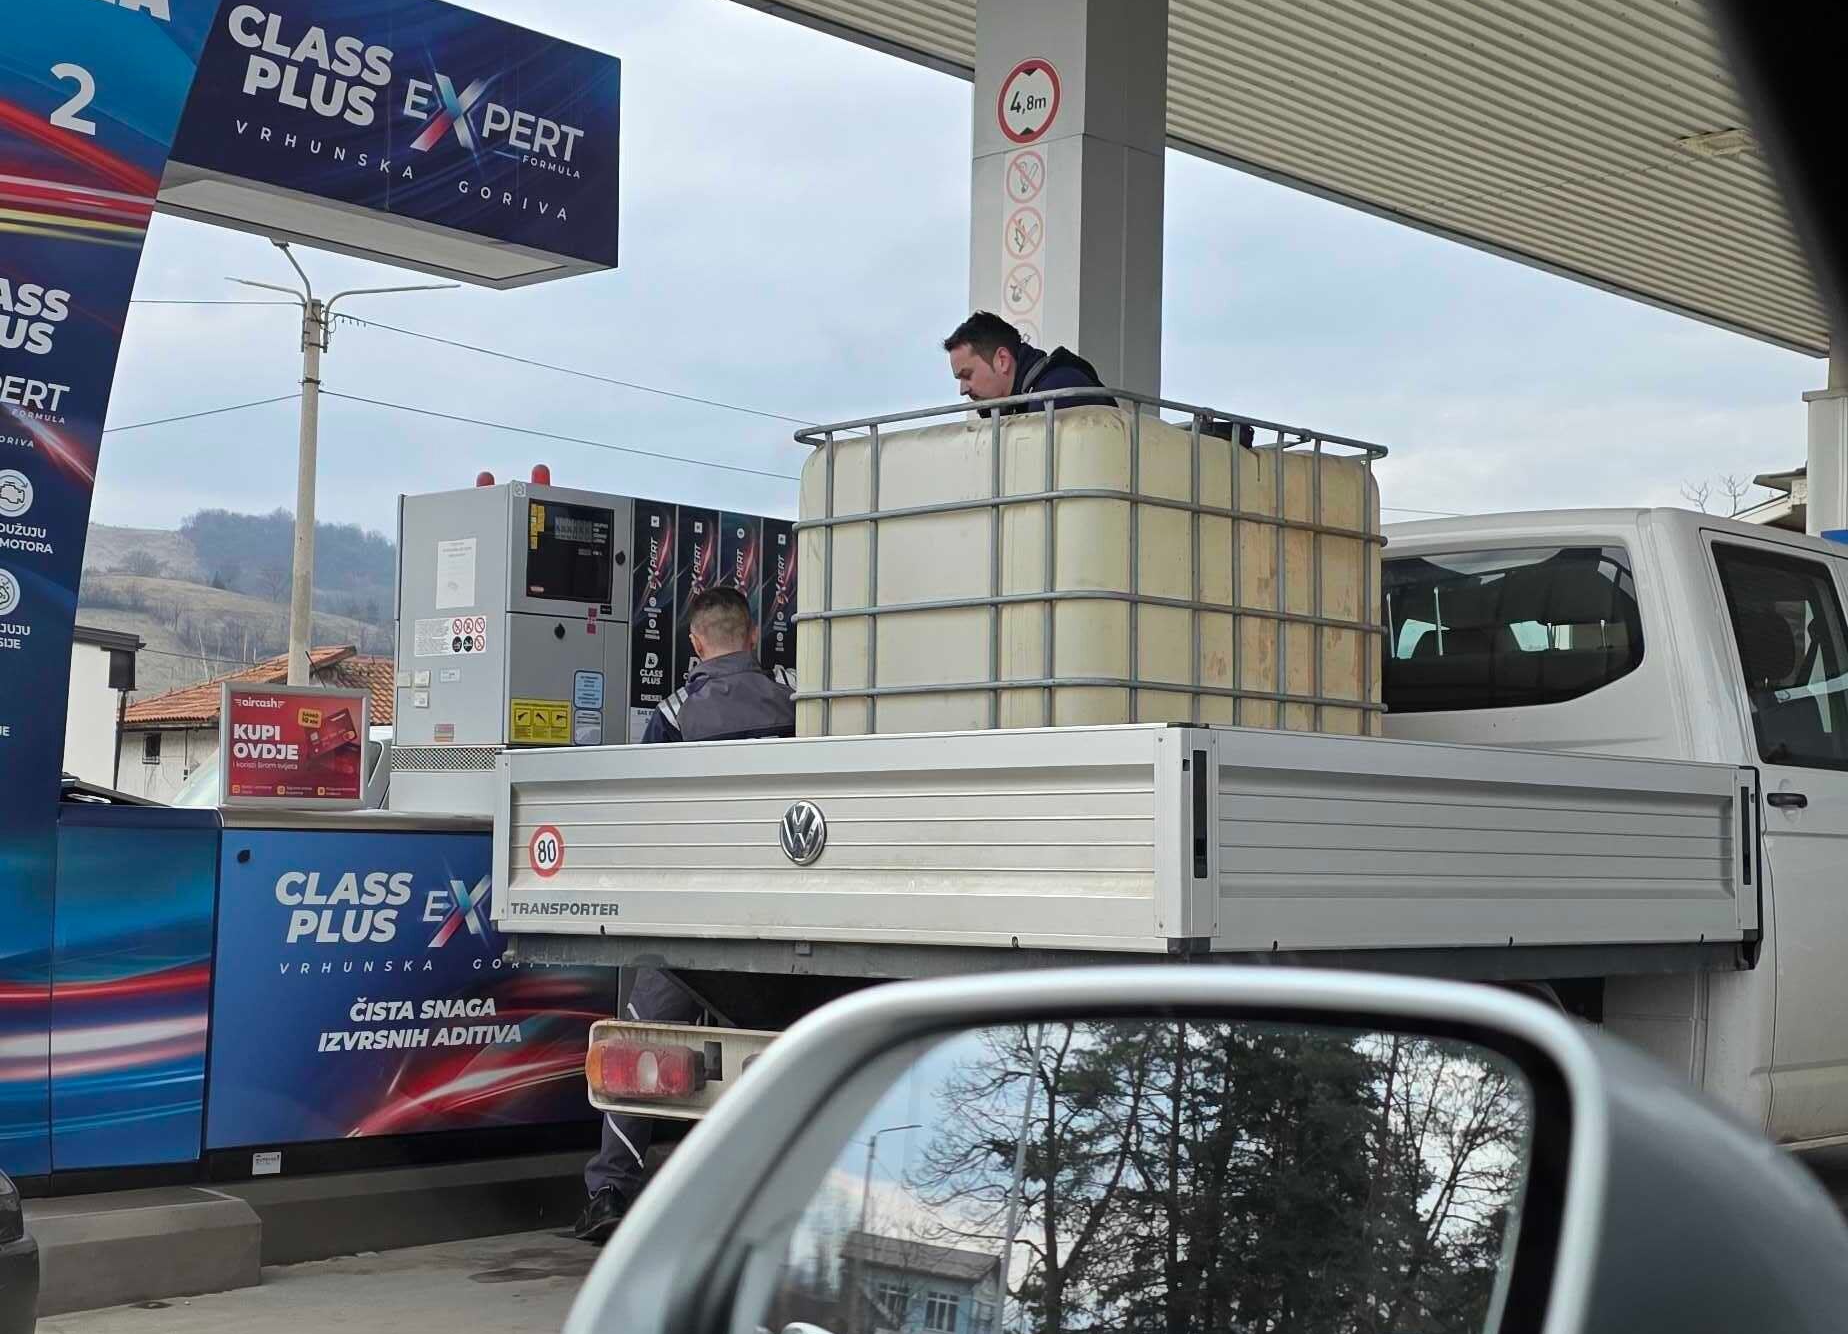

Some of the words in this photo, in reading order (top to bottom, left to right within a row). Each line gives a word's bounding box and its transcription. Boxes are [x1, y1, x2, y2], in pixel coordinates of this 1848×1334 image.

[227, 4, 395, 85] CLASS
[49, 63, 96, 136] 2
[241, 54, 377, 126] PLUS
[1010, 91, 1046, 114] 4,8m
[235, 119, 414, 180] VRHUNSKA
[457, 179, 569, 222] GORIVA
[522, 154, 582, 180] FORMULA
[0, 375, 70, 412] ERT
[12, 408, 65, 424] FORMULA
[639, 669, 663, 678] CLASS
[641, 677, 661, 685] PLUS
[234, 724, 280, 741] KUPI
[233, 743, 299, 760] OVDJE
[537, 839, 556, 864] 80
[275, 872, 413, 905] CLASS
[511, 902, 619, 916] TRANSPORTER
[285, 909, 398, 944] PLUS
[279, 960, 433, 975] VRHUNSKA
[349, 996, 414, 1023] ČISTA
[420, 997, 496, 1020] SNAGA
[318, 1028, 427, 1052] IZVRSNIH
[432, 1024, 522, 1047] ADITIVA
